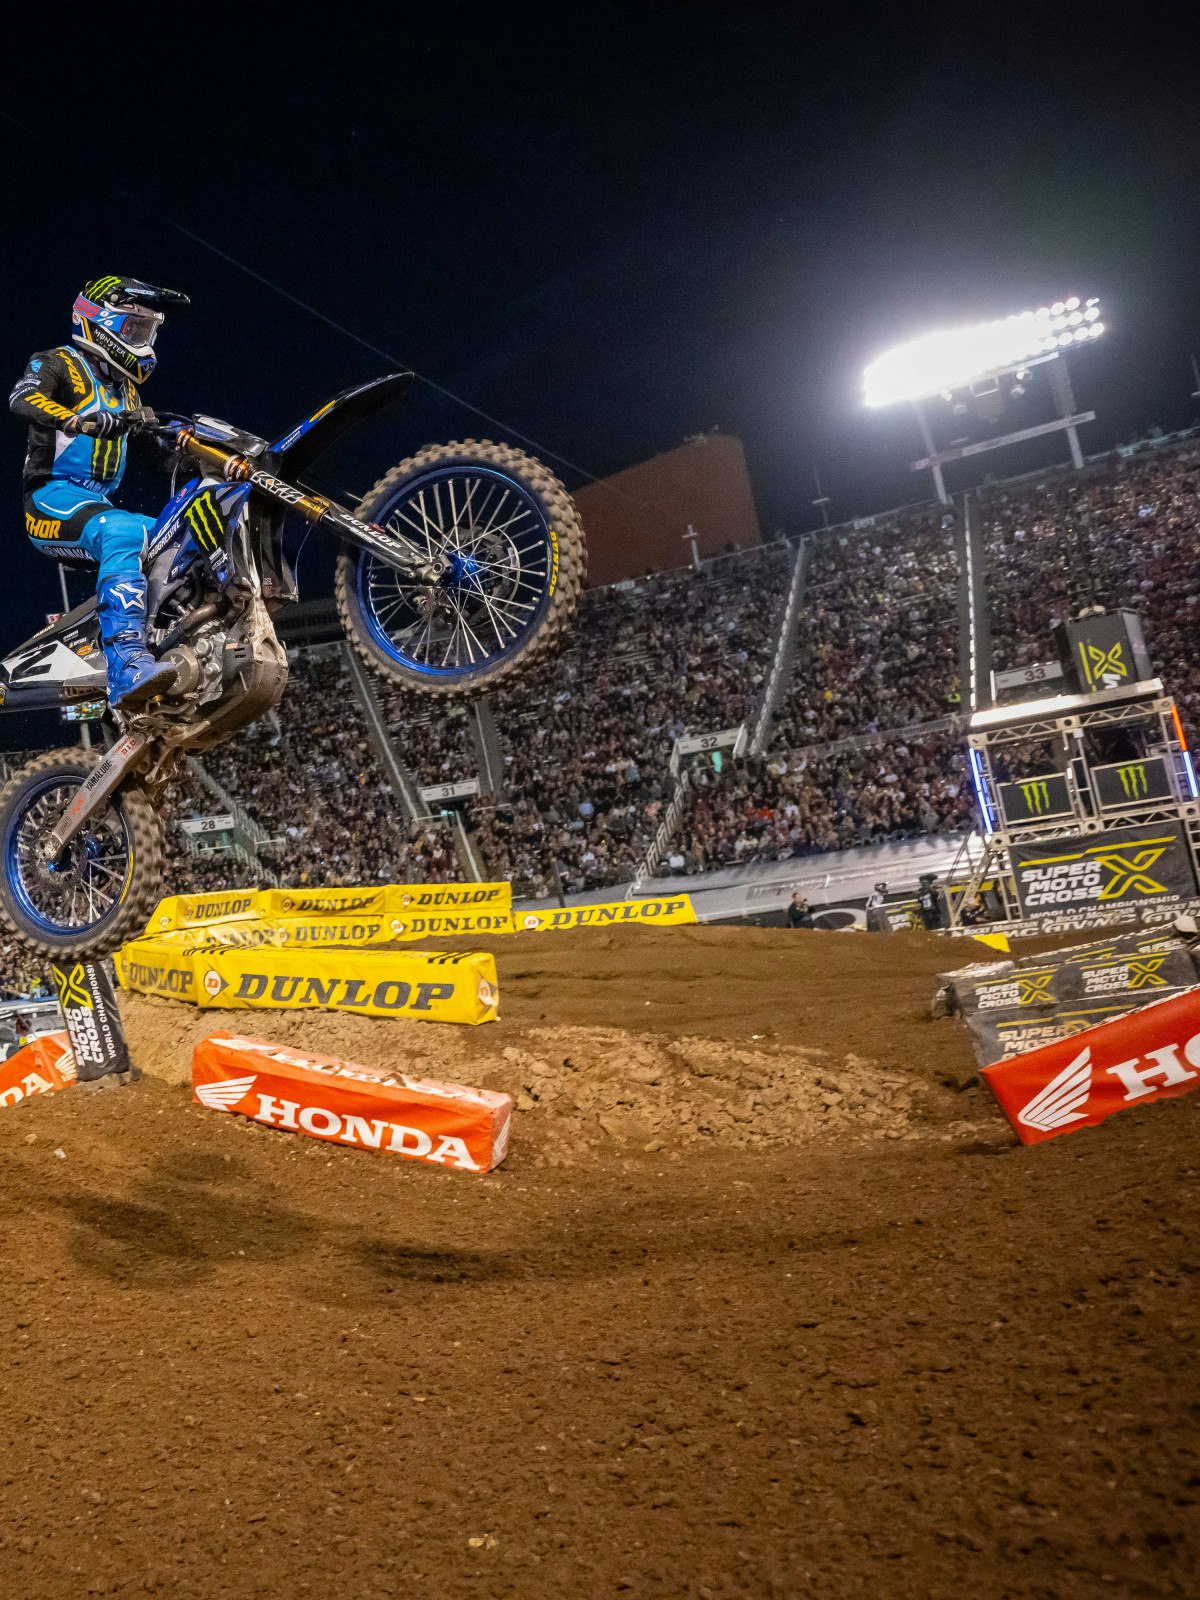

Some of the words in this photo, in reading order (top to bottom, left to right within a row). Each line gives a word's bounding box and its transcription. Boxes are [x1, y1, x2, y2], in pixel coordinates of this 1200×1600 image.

[25, 391, 76, 420] THOR
[250, 470, 305, 504] KYB
[25, 512, 62, 539] THOR
[340, 514, 403, 549] DUNLOP
[1024, 668, 1046, 682] 33
[701, 737, 718, 748] 32
[84, 759, 113, 792] YAMALUBE
[441, 786, 456, 798] 31
[201, 820, 216, 831] 28
[1021, 861, 1102, 883] SUPER
[1028, 873, 1101, 895] MOTO
[296, 896, 375, 912] DUNLOP
[417, 889, 500, 905] DUNLOP
[1025, 885, 1104, 907] CROSS
[194, 898, 252, 919] DUNLOP
[552, 901, 686, 928] DUNLOP
[295, 924, 381, 942] DUNLOP
[411, 916, 508, 933] DUNLOP
[129, 962, 193, 994] DUNLOP
[1082, 965, 1129, 979] SUPER
[1087, 973, 1129, 985] MOTO
[234, 973, 455, 1011] DUNLOP
[975, 982, 1020, 996] SUPER
[980, 990, 1020, 1002] MOTO
[1084, 980, 1131, 993] CROSS
[977, 997, 1021, 1009] CROSS
[71, 1008, 94, 1062] MOTO
[80, 1005, 105, 1064] CROSS
[102, 1024, 117, 1059] WORLD
[997, 1025, 1068, 1042] SUPER
[253, 1093, 481, 1171] HONDA
